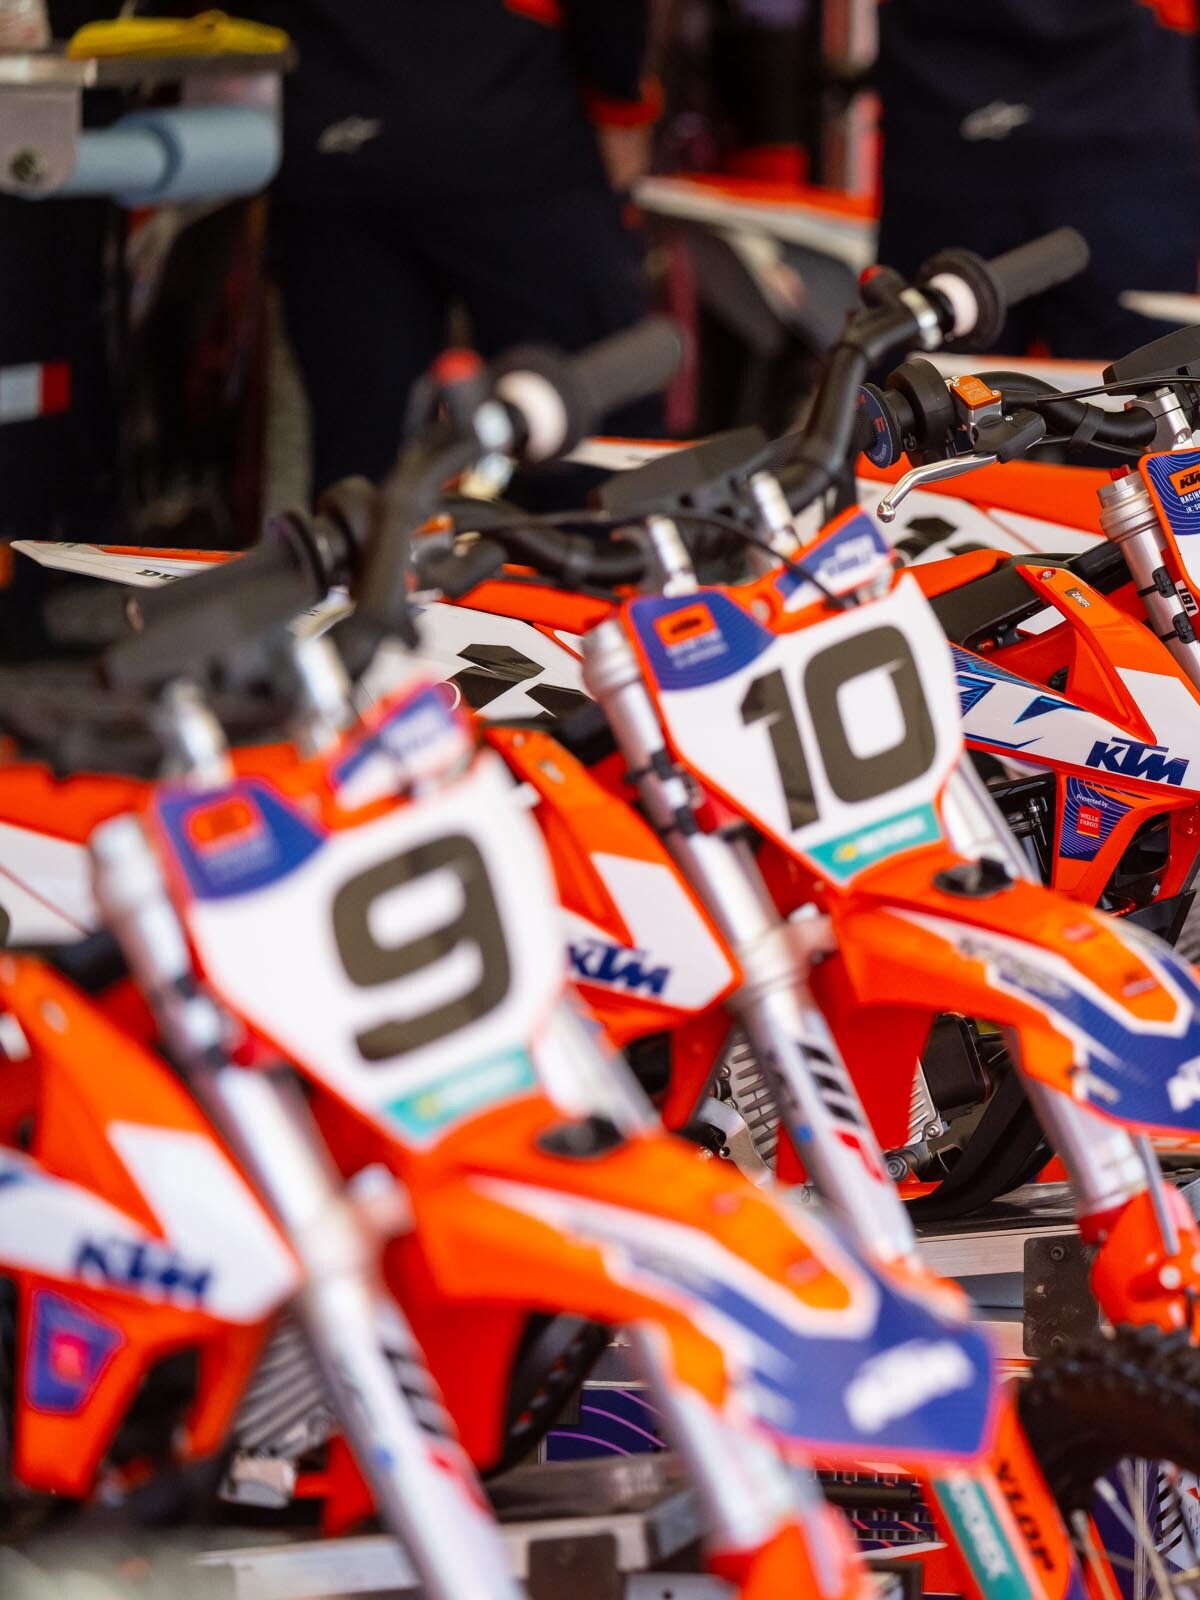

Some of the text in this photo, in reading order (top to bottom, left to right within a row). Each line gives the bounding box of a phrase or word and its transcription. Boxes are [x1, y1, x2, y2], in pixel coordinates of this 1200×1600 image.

[741, 624, 937, 832] 10
[1085, 736, 1190, 787] KTM
[1080, 812, 1099, 822] WELLS
[1101, 801, 1109, 809] by
[1080, 819, 1099, 829] FARGO
[332, 833, 512, 1062] 9
